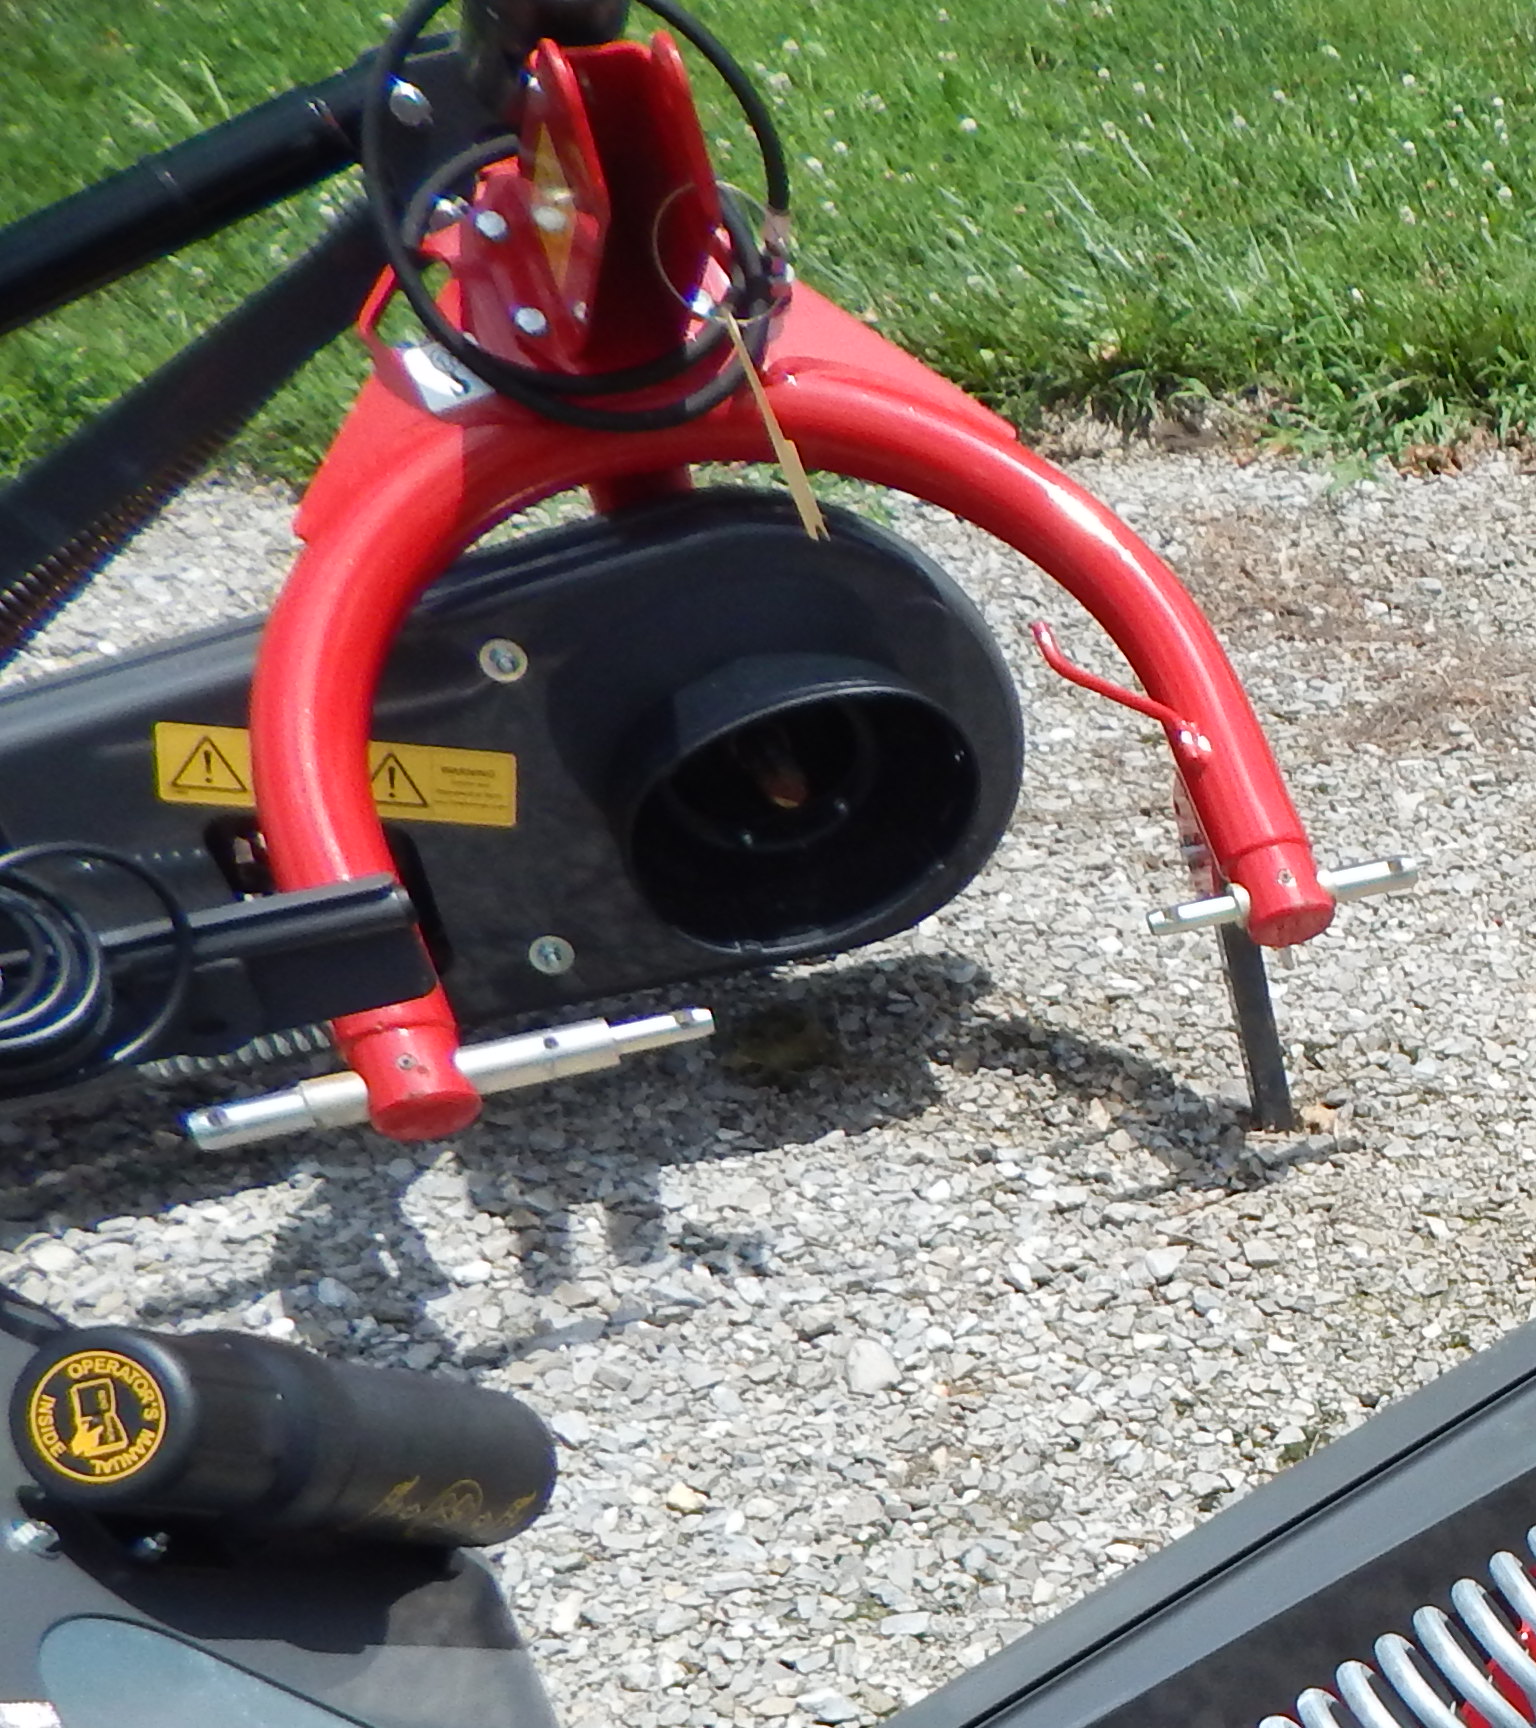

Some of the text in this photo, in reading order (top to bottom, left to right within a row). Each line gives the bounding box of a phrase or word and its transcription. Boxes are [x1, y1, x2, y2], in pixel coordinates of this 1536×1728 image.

[67, 1358, 160, 1421] OPERATOR'S
[37, 1394, 67, 1458] INSIDE
[90, 1428, 156, 1474] MANUAL
